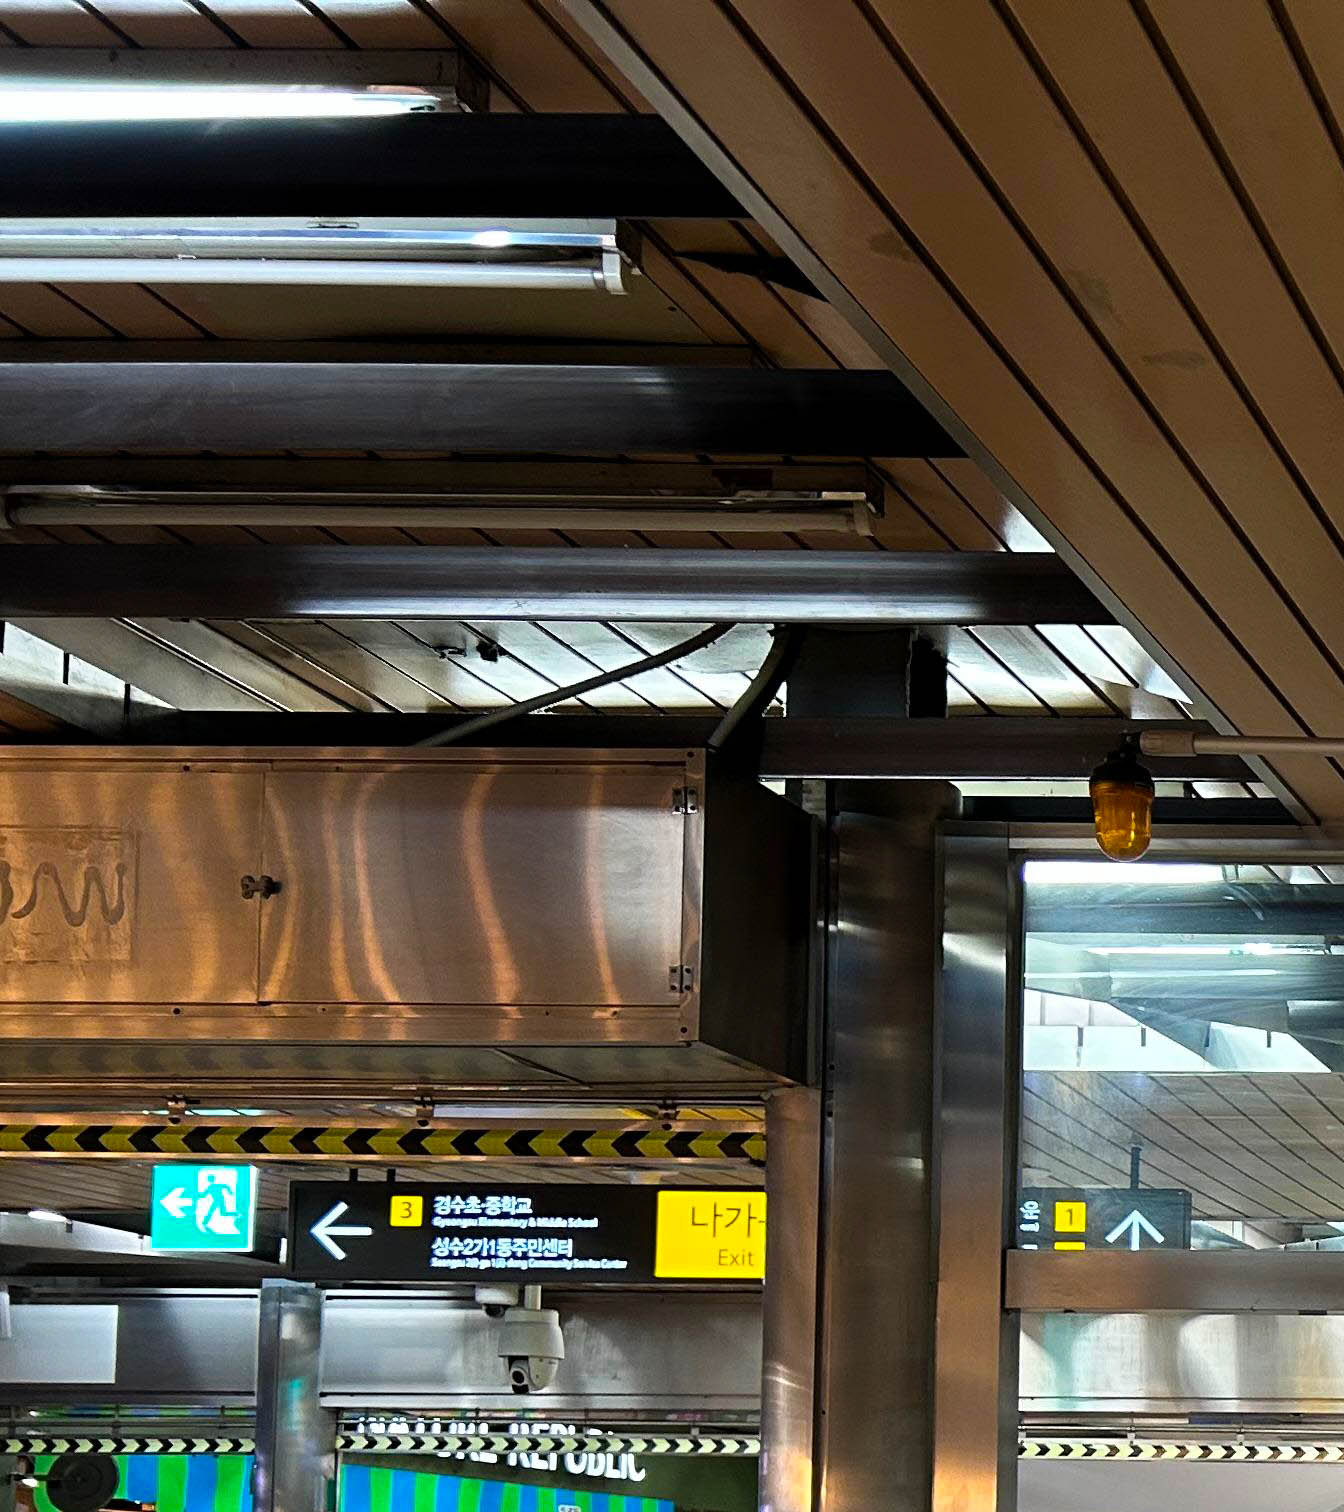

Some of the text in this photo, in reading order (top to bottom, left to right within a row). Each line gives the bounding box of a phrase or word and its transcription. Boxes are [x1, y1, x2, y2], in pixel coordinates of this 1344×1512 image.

[399, 1201, 412, 1219] 3
[1066, 1208, 1074, 1226] 1
[691, 1202, 765, 1238] 나가
[718, 1248, 755, 1267] Exit
